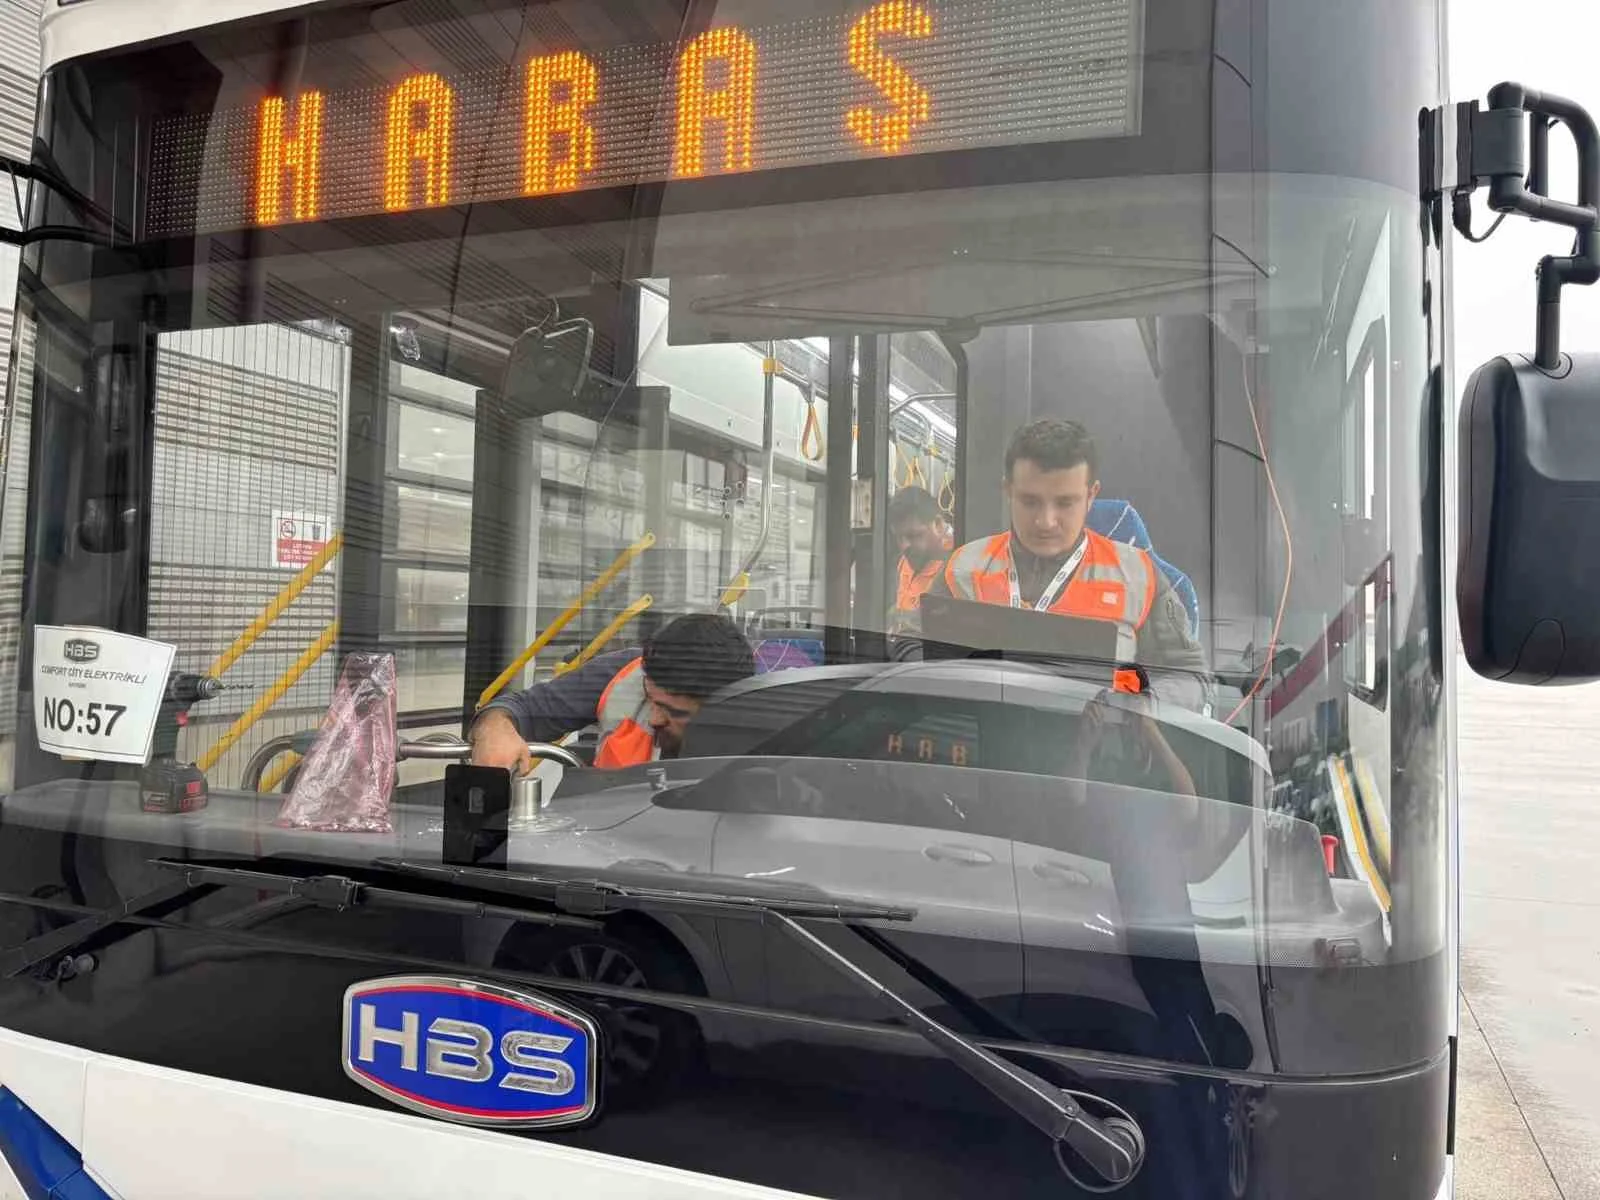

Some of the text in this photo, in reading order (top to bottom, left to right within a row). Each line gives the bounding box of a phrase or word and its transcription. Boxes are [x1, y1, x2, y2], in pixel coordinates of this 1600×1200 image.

[256, 0, 932, 225] HABAS
[64, 641, 98, 657] HBS
[43, 696, 128, 737] NO:57
[357, 1003, 577, 1097] HBS
